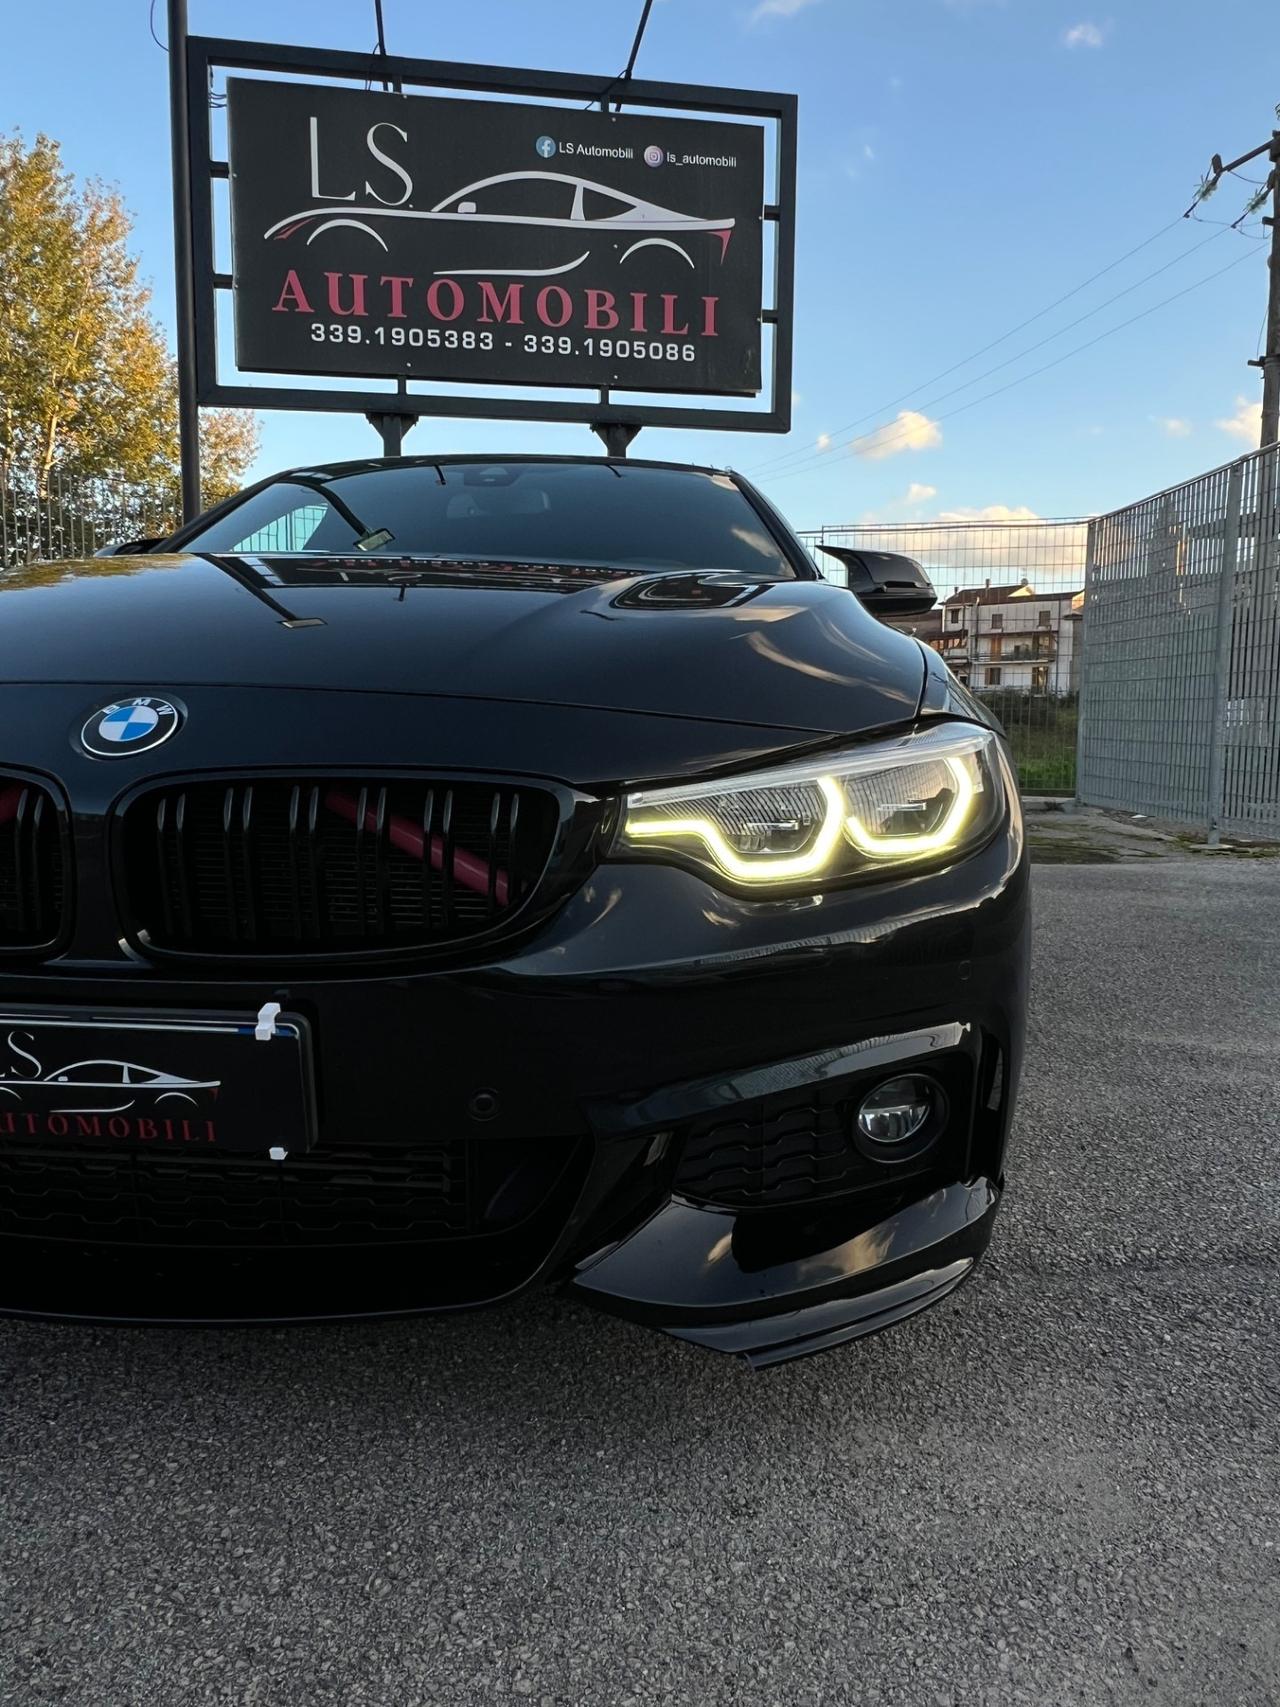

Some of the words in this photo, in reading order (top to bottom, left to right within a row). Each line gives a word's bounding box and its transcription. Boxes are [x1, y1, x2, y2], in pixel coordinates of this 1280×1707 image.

[310, 116, 413, 206] LS
[559, 142, 574, 154] LS
[576, 143, 634, 159] Automobili
[666, 151, 737, 168] ls_automobili
[272, 269, 719, 337] AUTOMOBILI
[311, 322, 494, 351] 339.1905383
[523, 334, 695, 362] 339.1905086
[102, 698, 174, 716] BMW
[0, 1030, 42, 1079] S
